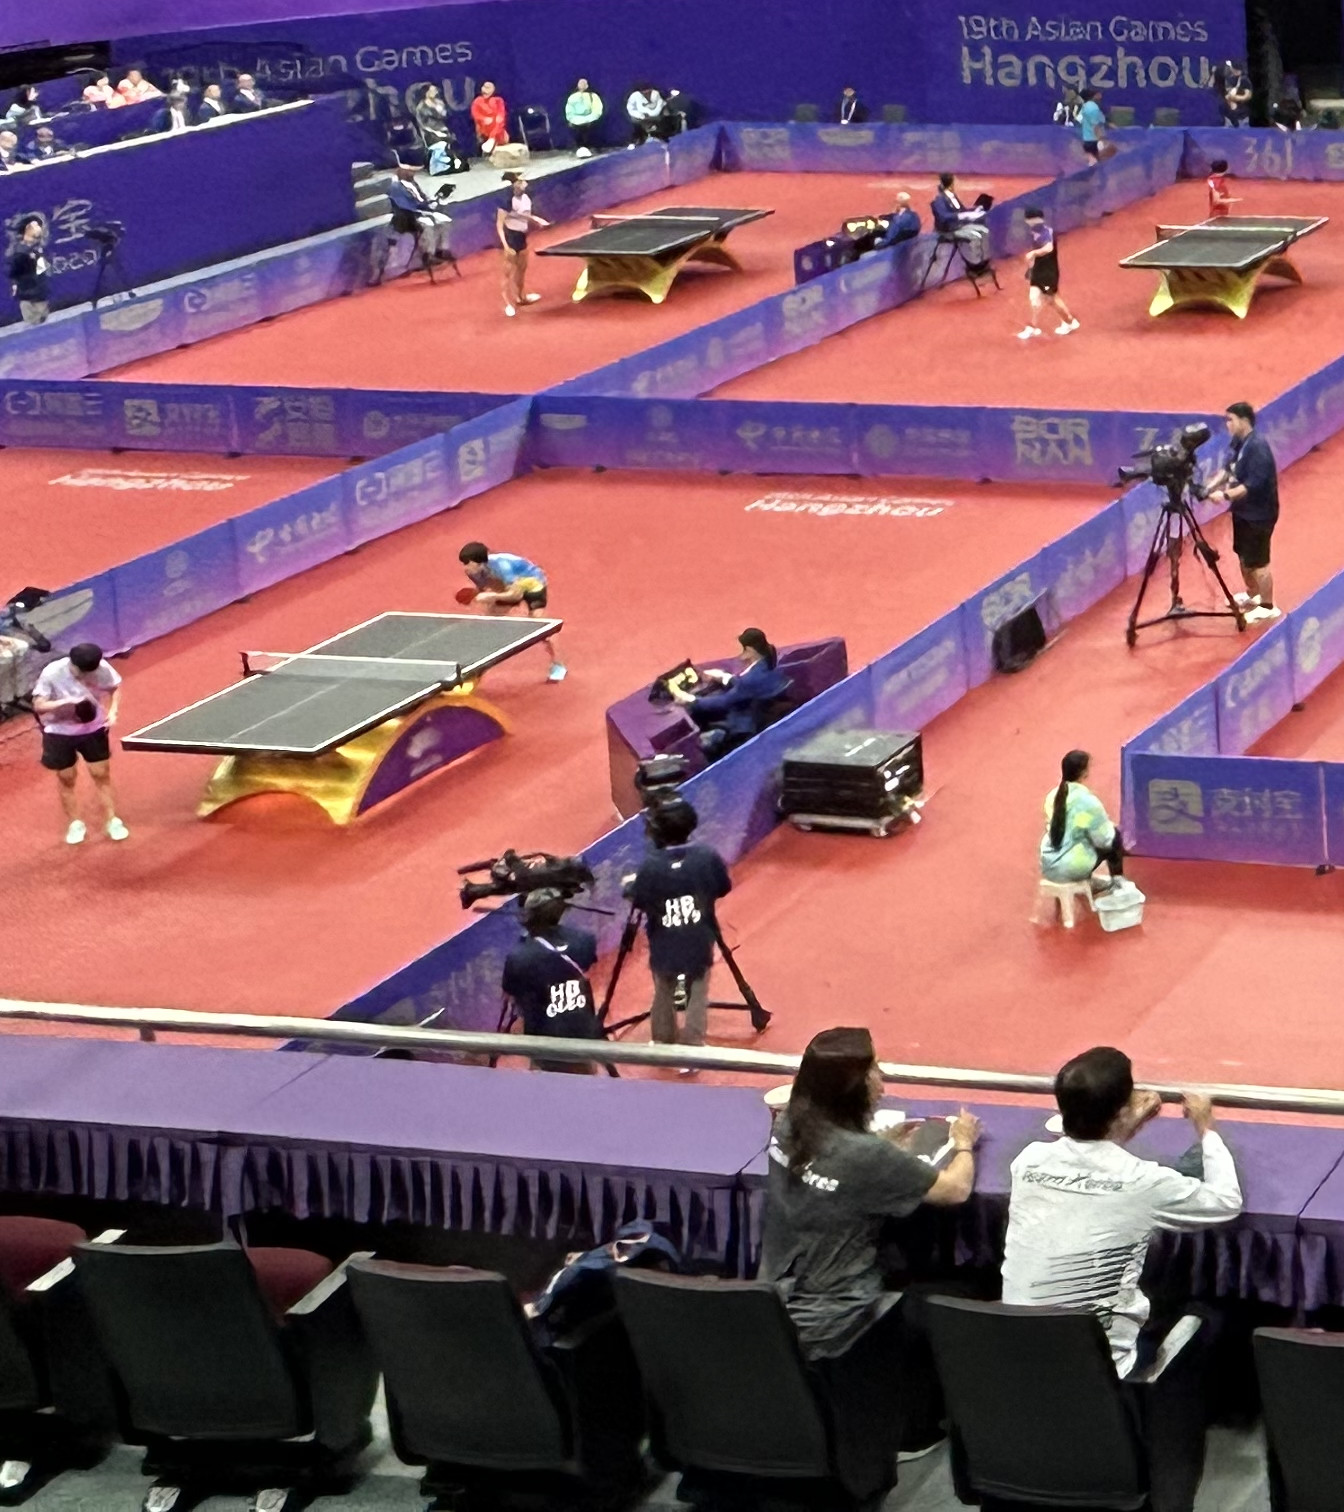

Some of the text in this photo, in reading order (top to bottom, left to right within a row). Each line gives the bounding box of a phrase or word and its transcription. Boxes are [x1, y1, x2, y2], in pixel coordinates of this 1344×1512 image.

[957, 15, 1209, 42] 19th Asian Games
[355, 41, 473, 73] Games
[961, 43, 1210, 92] Hangzhou
[744, 497, 945, 518] Hangzhou
[665, 894, 695, 915] HB
